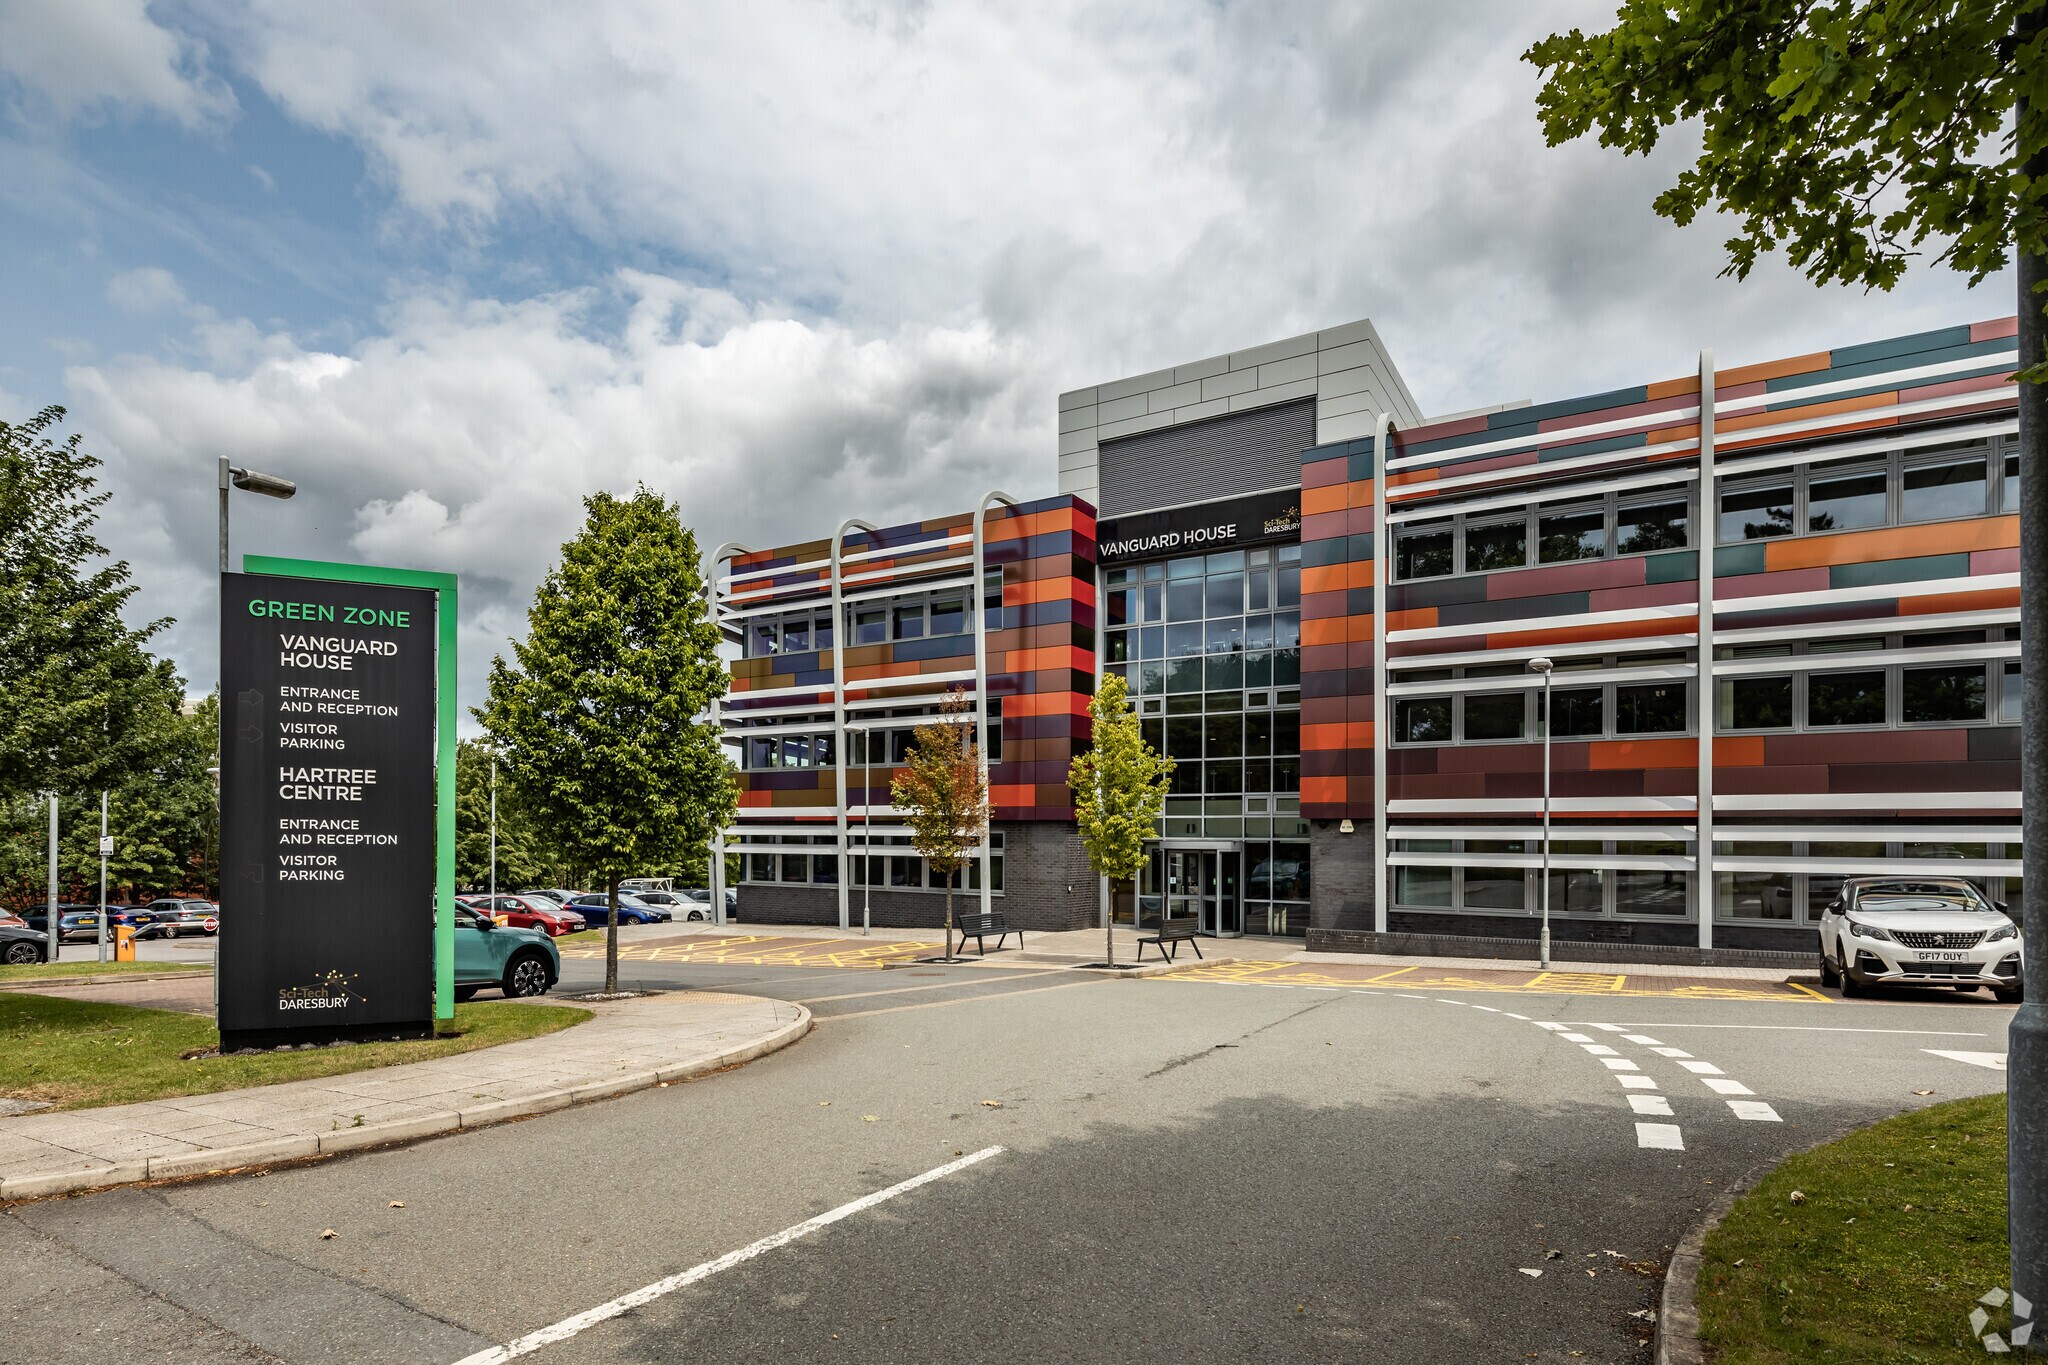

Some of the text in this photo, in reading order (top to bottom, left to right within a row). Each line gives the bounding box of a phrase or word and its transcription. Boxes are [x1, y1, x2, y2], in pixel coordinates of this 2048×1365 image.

[1264, 517, 1290, 528] Sci-Tech
[1264, 522, 1300, 534] DARESBURY
[1100, 524, 1236, 556] VANGUARD HOUSE
[248, 600, 410, 628] GREEN ZONE
[280, 634, 398, 656] VANGUARD
[280, 652, 352, 670] HOUSE
[280, 686, 360, 700] ENTRANCE
[280, 702, 398, 716] AND RECEPTION
[280, 723, 338, 735] VISITOR
[280, 738, 345, 750] PARKING
[280, 767, 376, 784] HARTREE
[280, 785, 362, 800] CENTRE
[280, 819, 359, 830] ENTRANCE
[280, 834, 398, 845] AND RECEPTION
[280, 855, 337, 866] VISITOR
[280, 870, 344, 882] PARKING
[279, 987, 328, 999] Sci-Tech
[280, 997, 349, 1010] DARESBURY
